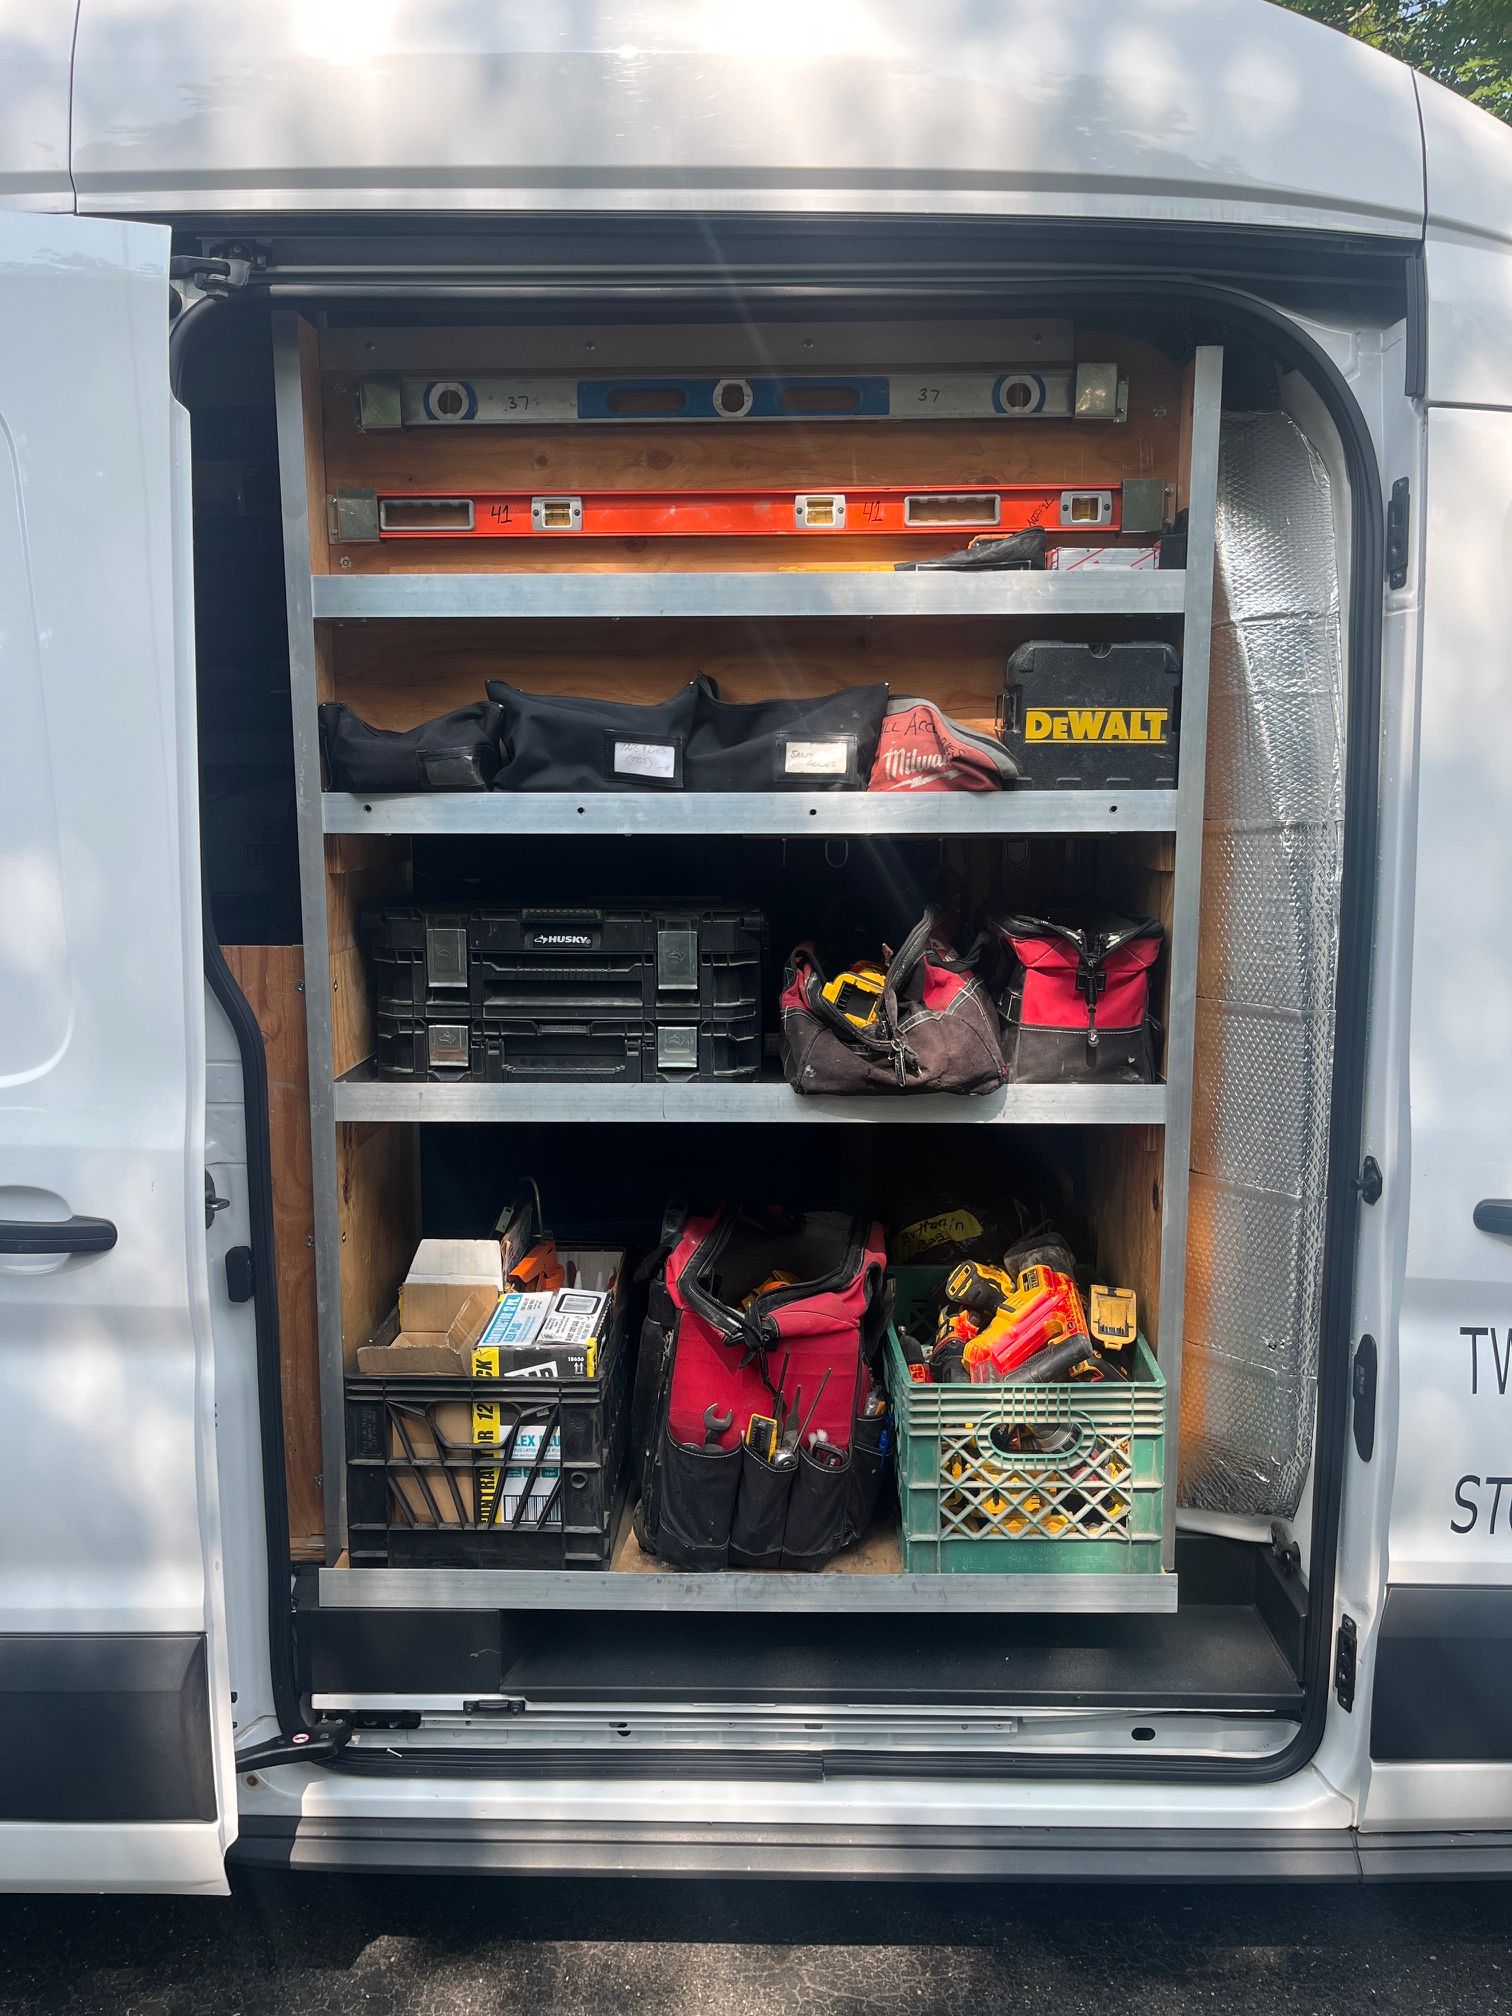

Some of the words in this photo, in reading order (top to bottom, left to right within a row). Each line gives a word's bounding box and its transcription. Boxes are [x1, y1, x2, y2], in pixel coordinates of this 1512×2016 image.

[508, 395, 529, 411] 37
[917, 388, 940, 403] 37
[490, 504, 513, 524] 41
[862, 500, 884, 523] 41
[1024, 710, 1168, 740] DEWALT
[548, 935, 588, 944] HUSKY
[1450, 1474, 1512, 1534] ST
